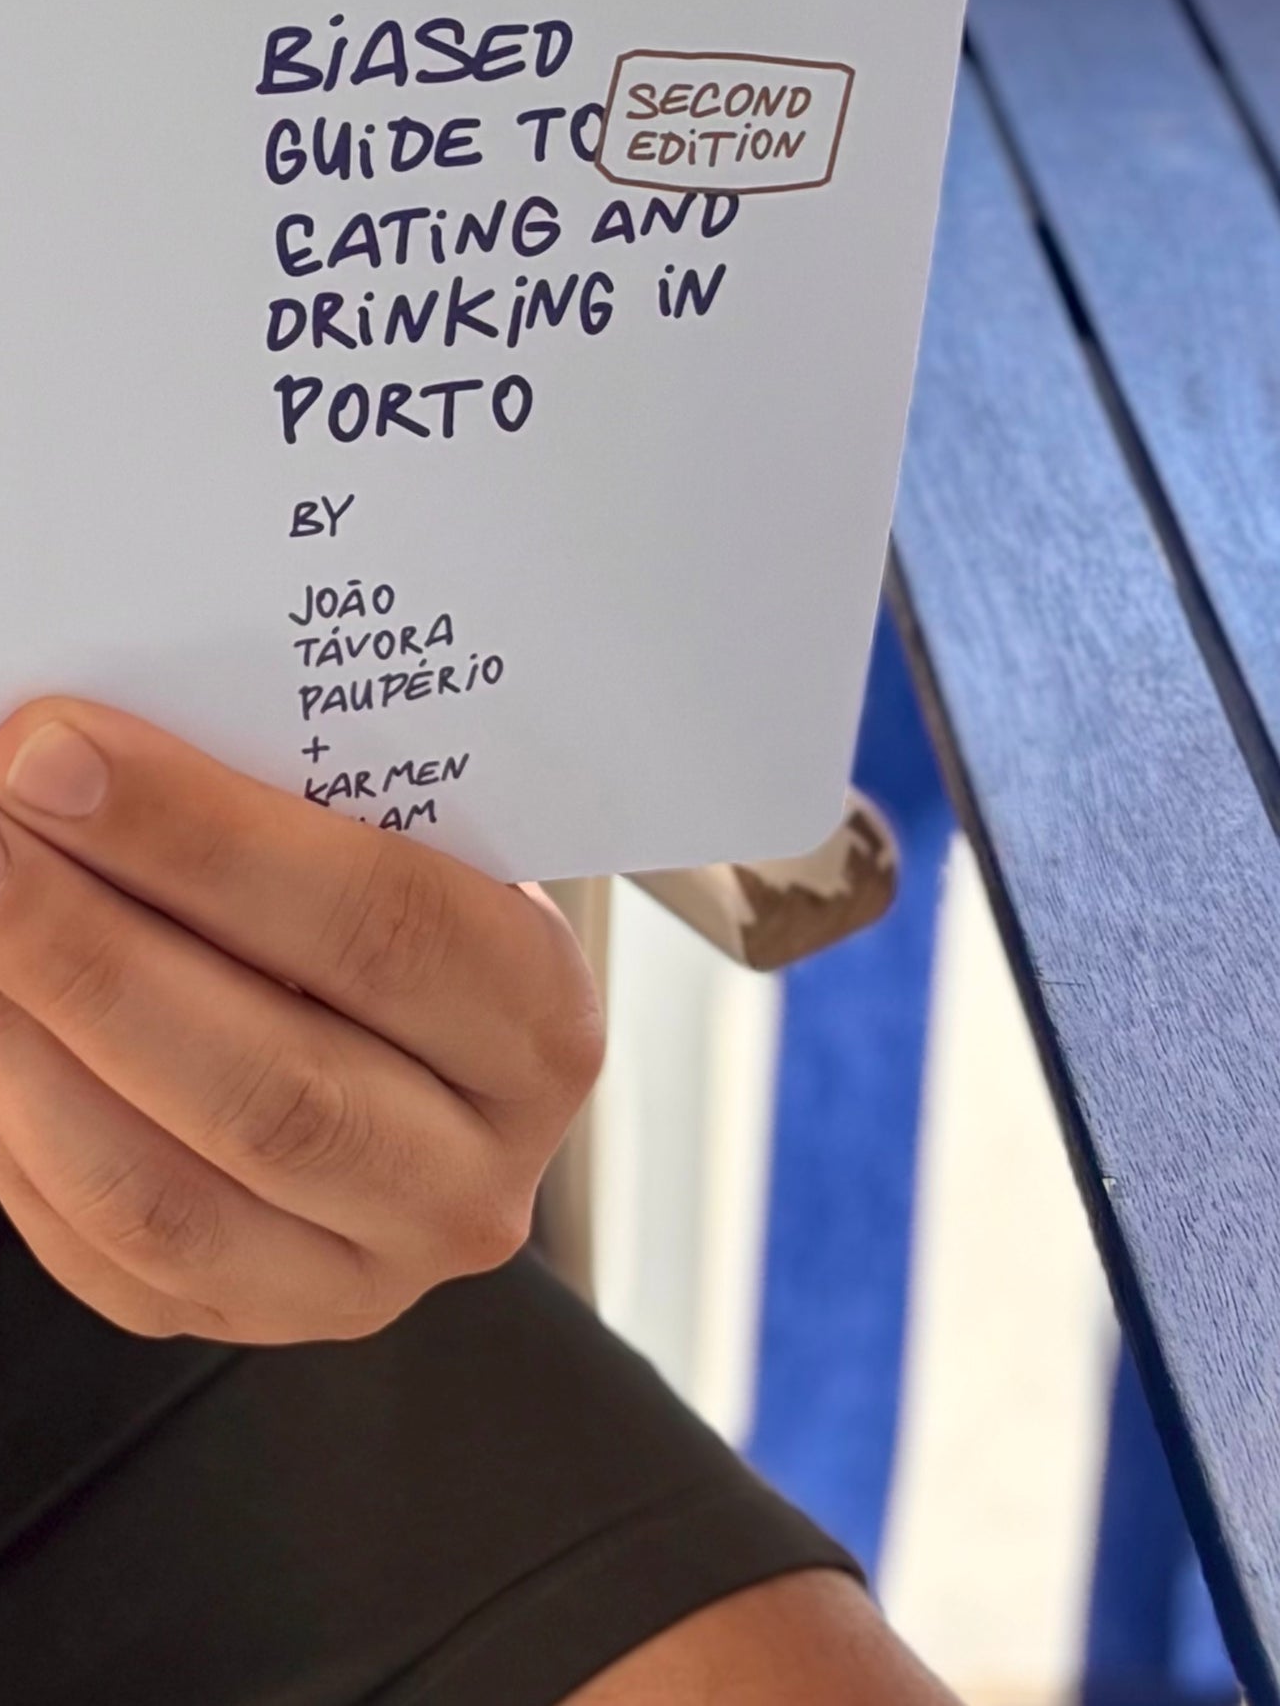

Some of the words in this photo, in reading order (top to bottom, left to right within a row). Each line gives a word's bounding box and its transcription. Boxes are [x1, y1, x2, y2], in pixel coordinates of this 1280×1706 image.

[626, 83, 812, 121] SECOND
[516, 103, 607, 164] TO
[591, 190, 740, 244] AND
[273, 374, 533, 444] PORTO
[289, 494, 355, 537] BY
[304, 753, 470, 808] KARMEN
